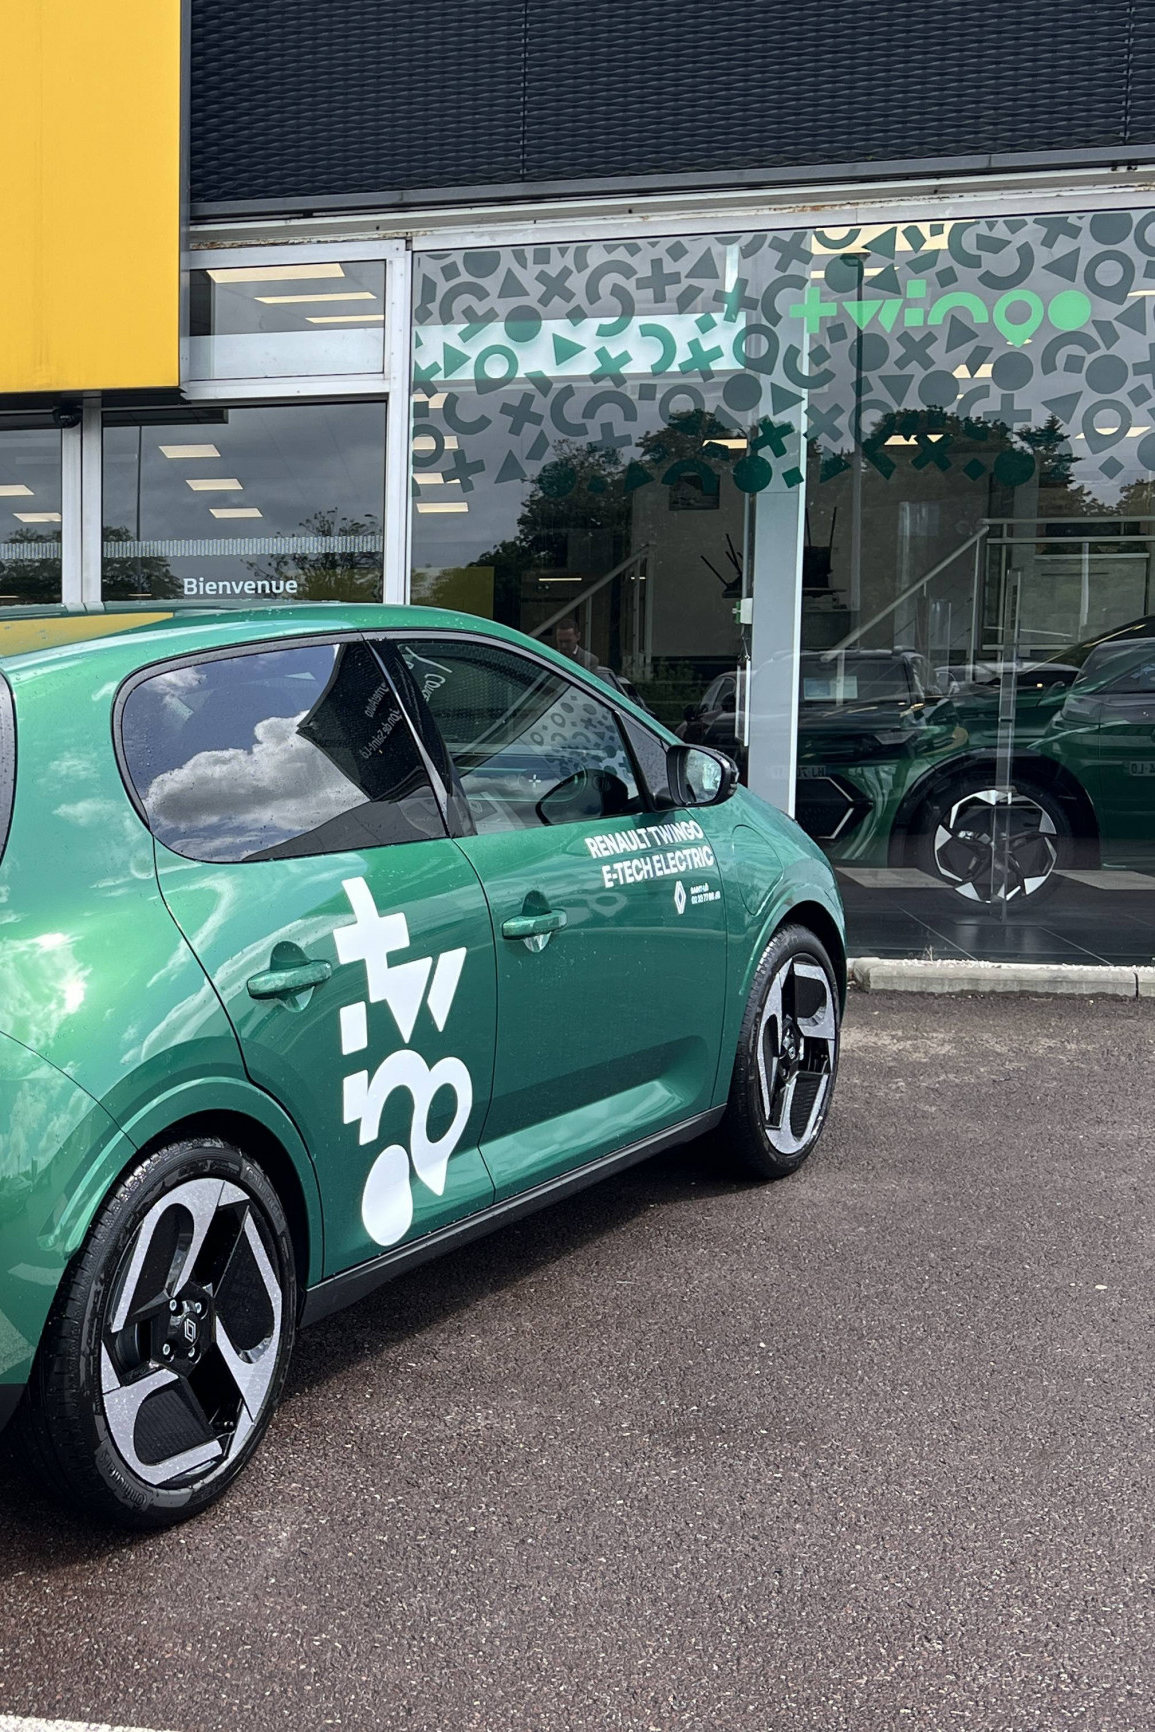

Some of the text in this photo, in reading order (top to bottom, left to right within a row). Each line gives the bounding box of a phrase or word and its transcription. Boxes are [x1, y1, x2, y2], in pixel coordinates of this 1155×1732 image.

[183, 577, 298, 595] Bienvenue
[585, 820, 704, 858] RENAULT TWINGO
[602, 845, 715, 888] E-TECH ELECTRIC
